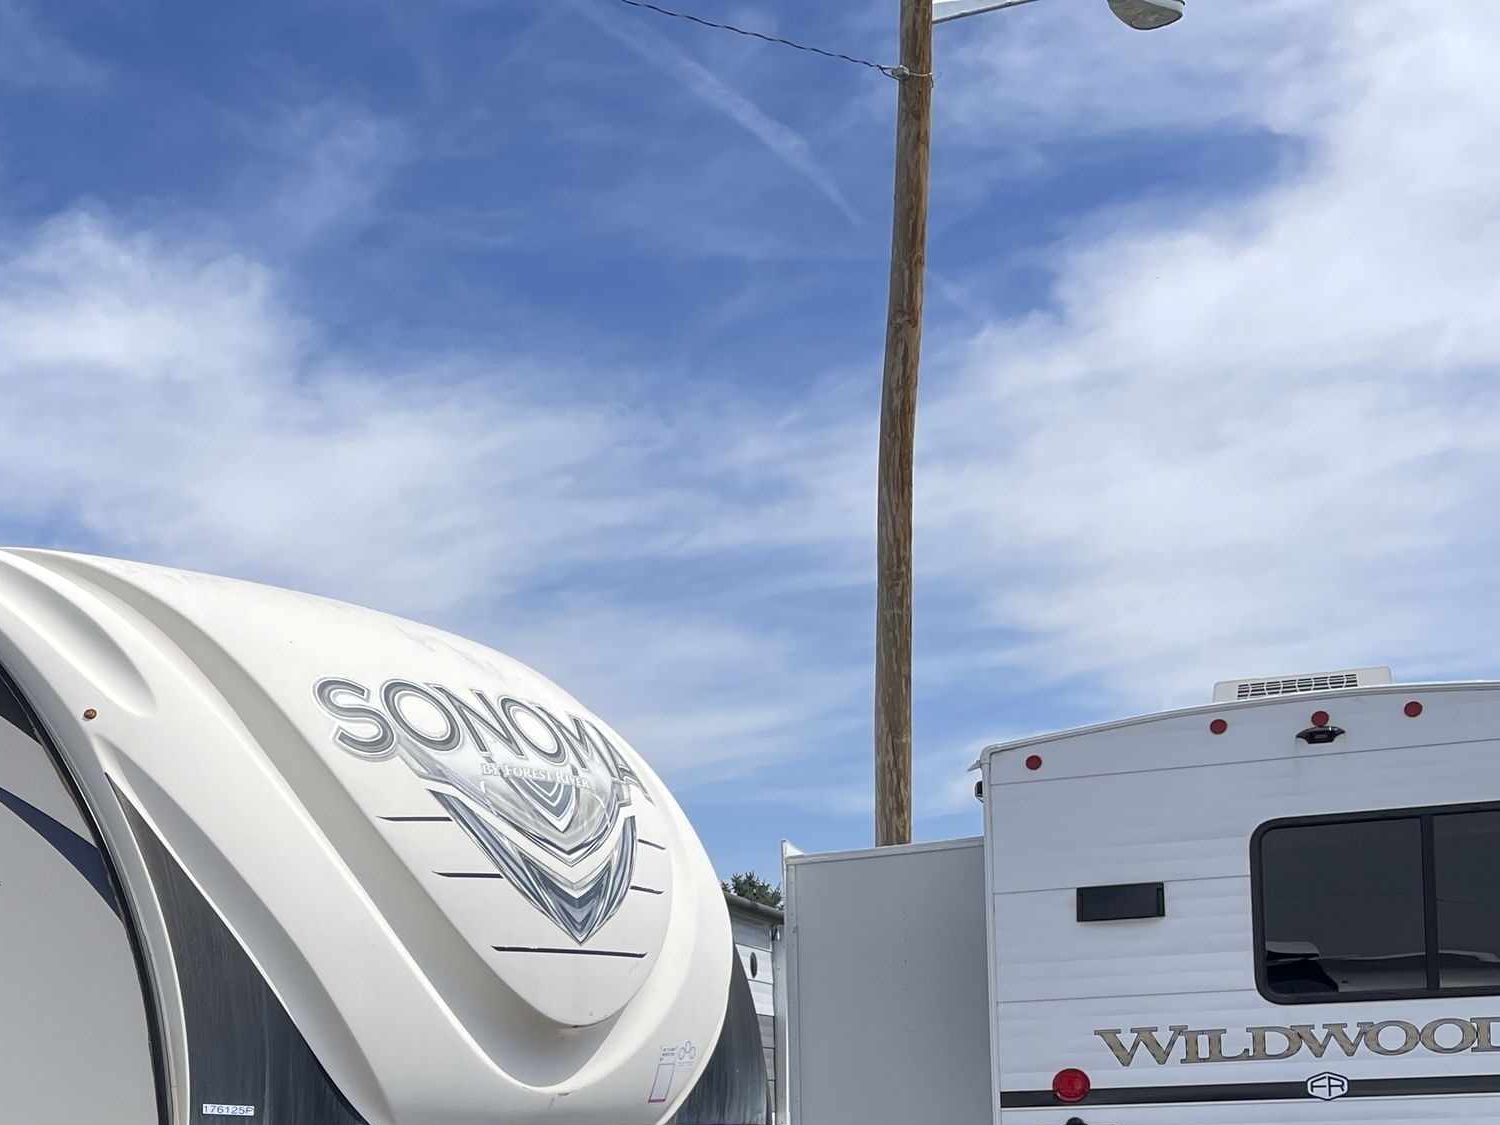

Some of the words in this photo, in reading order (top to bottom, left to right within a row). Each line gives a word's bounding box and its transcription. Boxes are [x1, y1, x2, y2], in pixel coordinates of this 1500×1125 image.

[313, 677, 655, 804] SONOMA
[481, 763, 499, 776] BY
[504, 765, 553, 782] FOREST
[556, 772, 590, 788] RIVER
